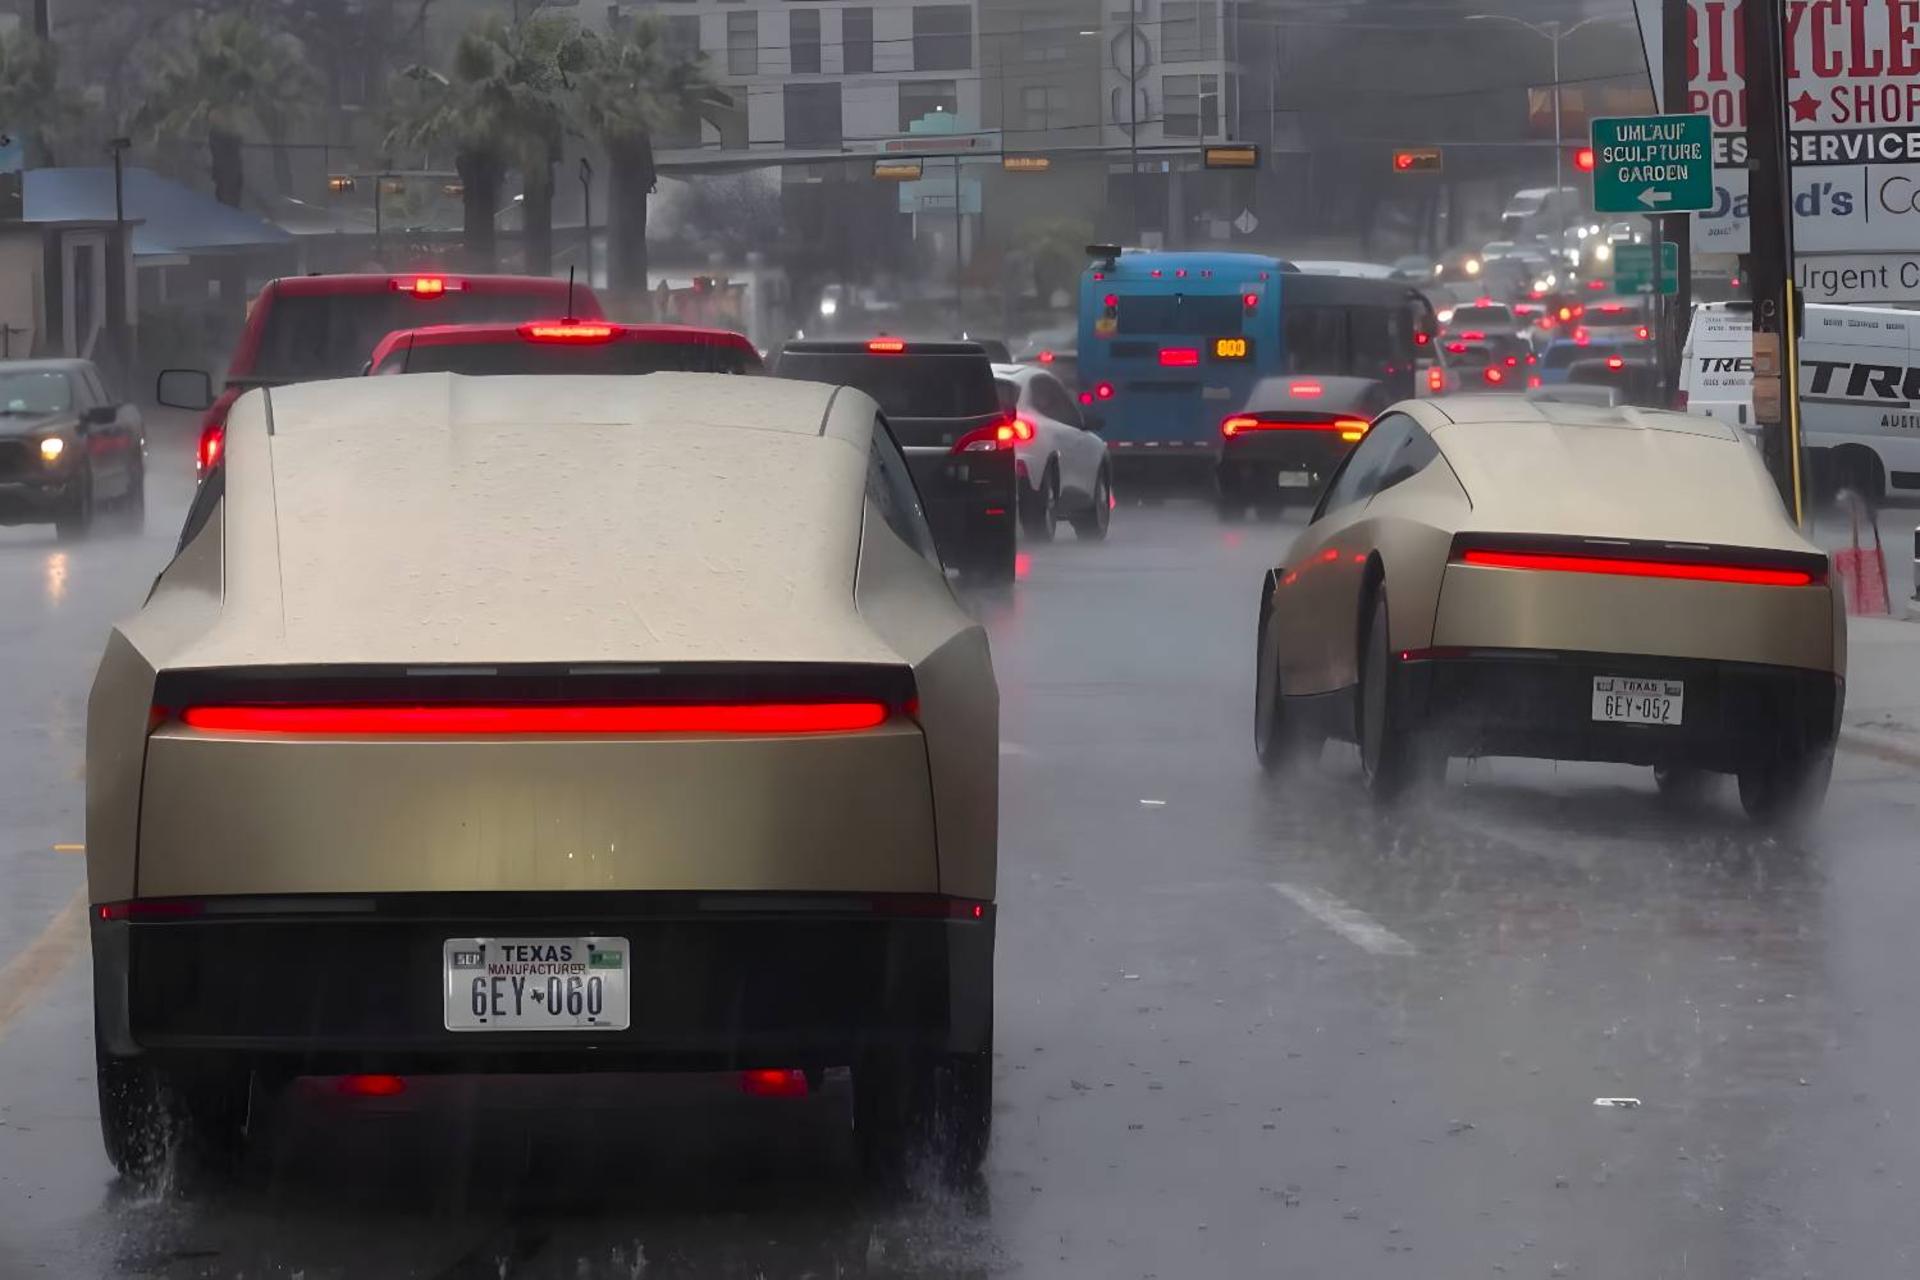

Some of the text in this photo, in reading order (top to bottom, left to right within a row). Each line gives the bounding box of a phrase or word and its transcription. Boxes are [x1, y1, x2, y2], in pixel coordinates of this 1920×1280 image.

[1616, 122, 1686, 142] UMLAUF
[1603, 143, 1702, 163] SCULPTURE
[1618, 164, 1688, 183] GARDEN
[1700, 357, 1753, 373] TRE
[501, 945, 572, 962] TEXAS
[488, 963, 586, 975] MANUFACTURER
